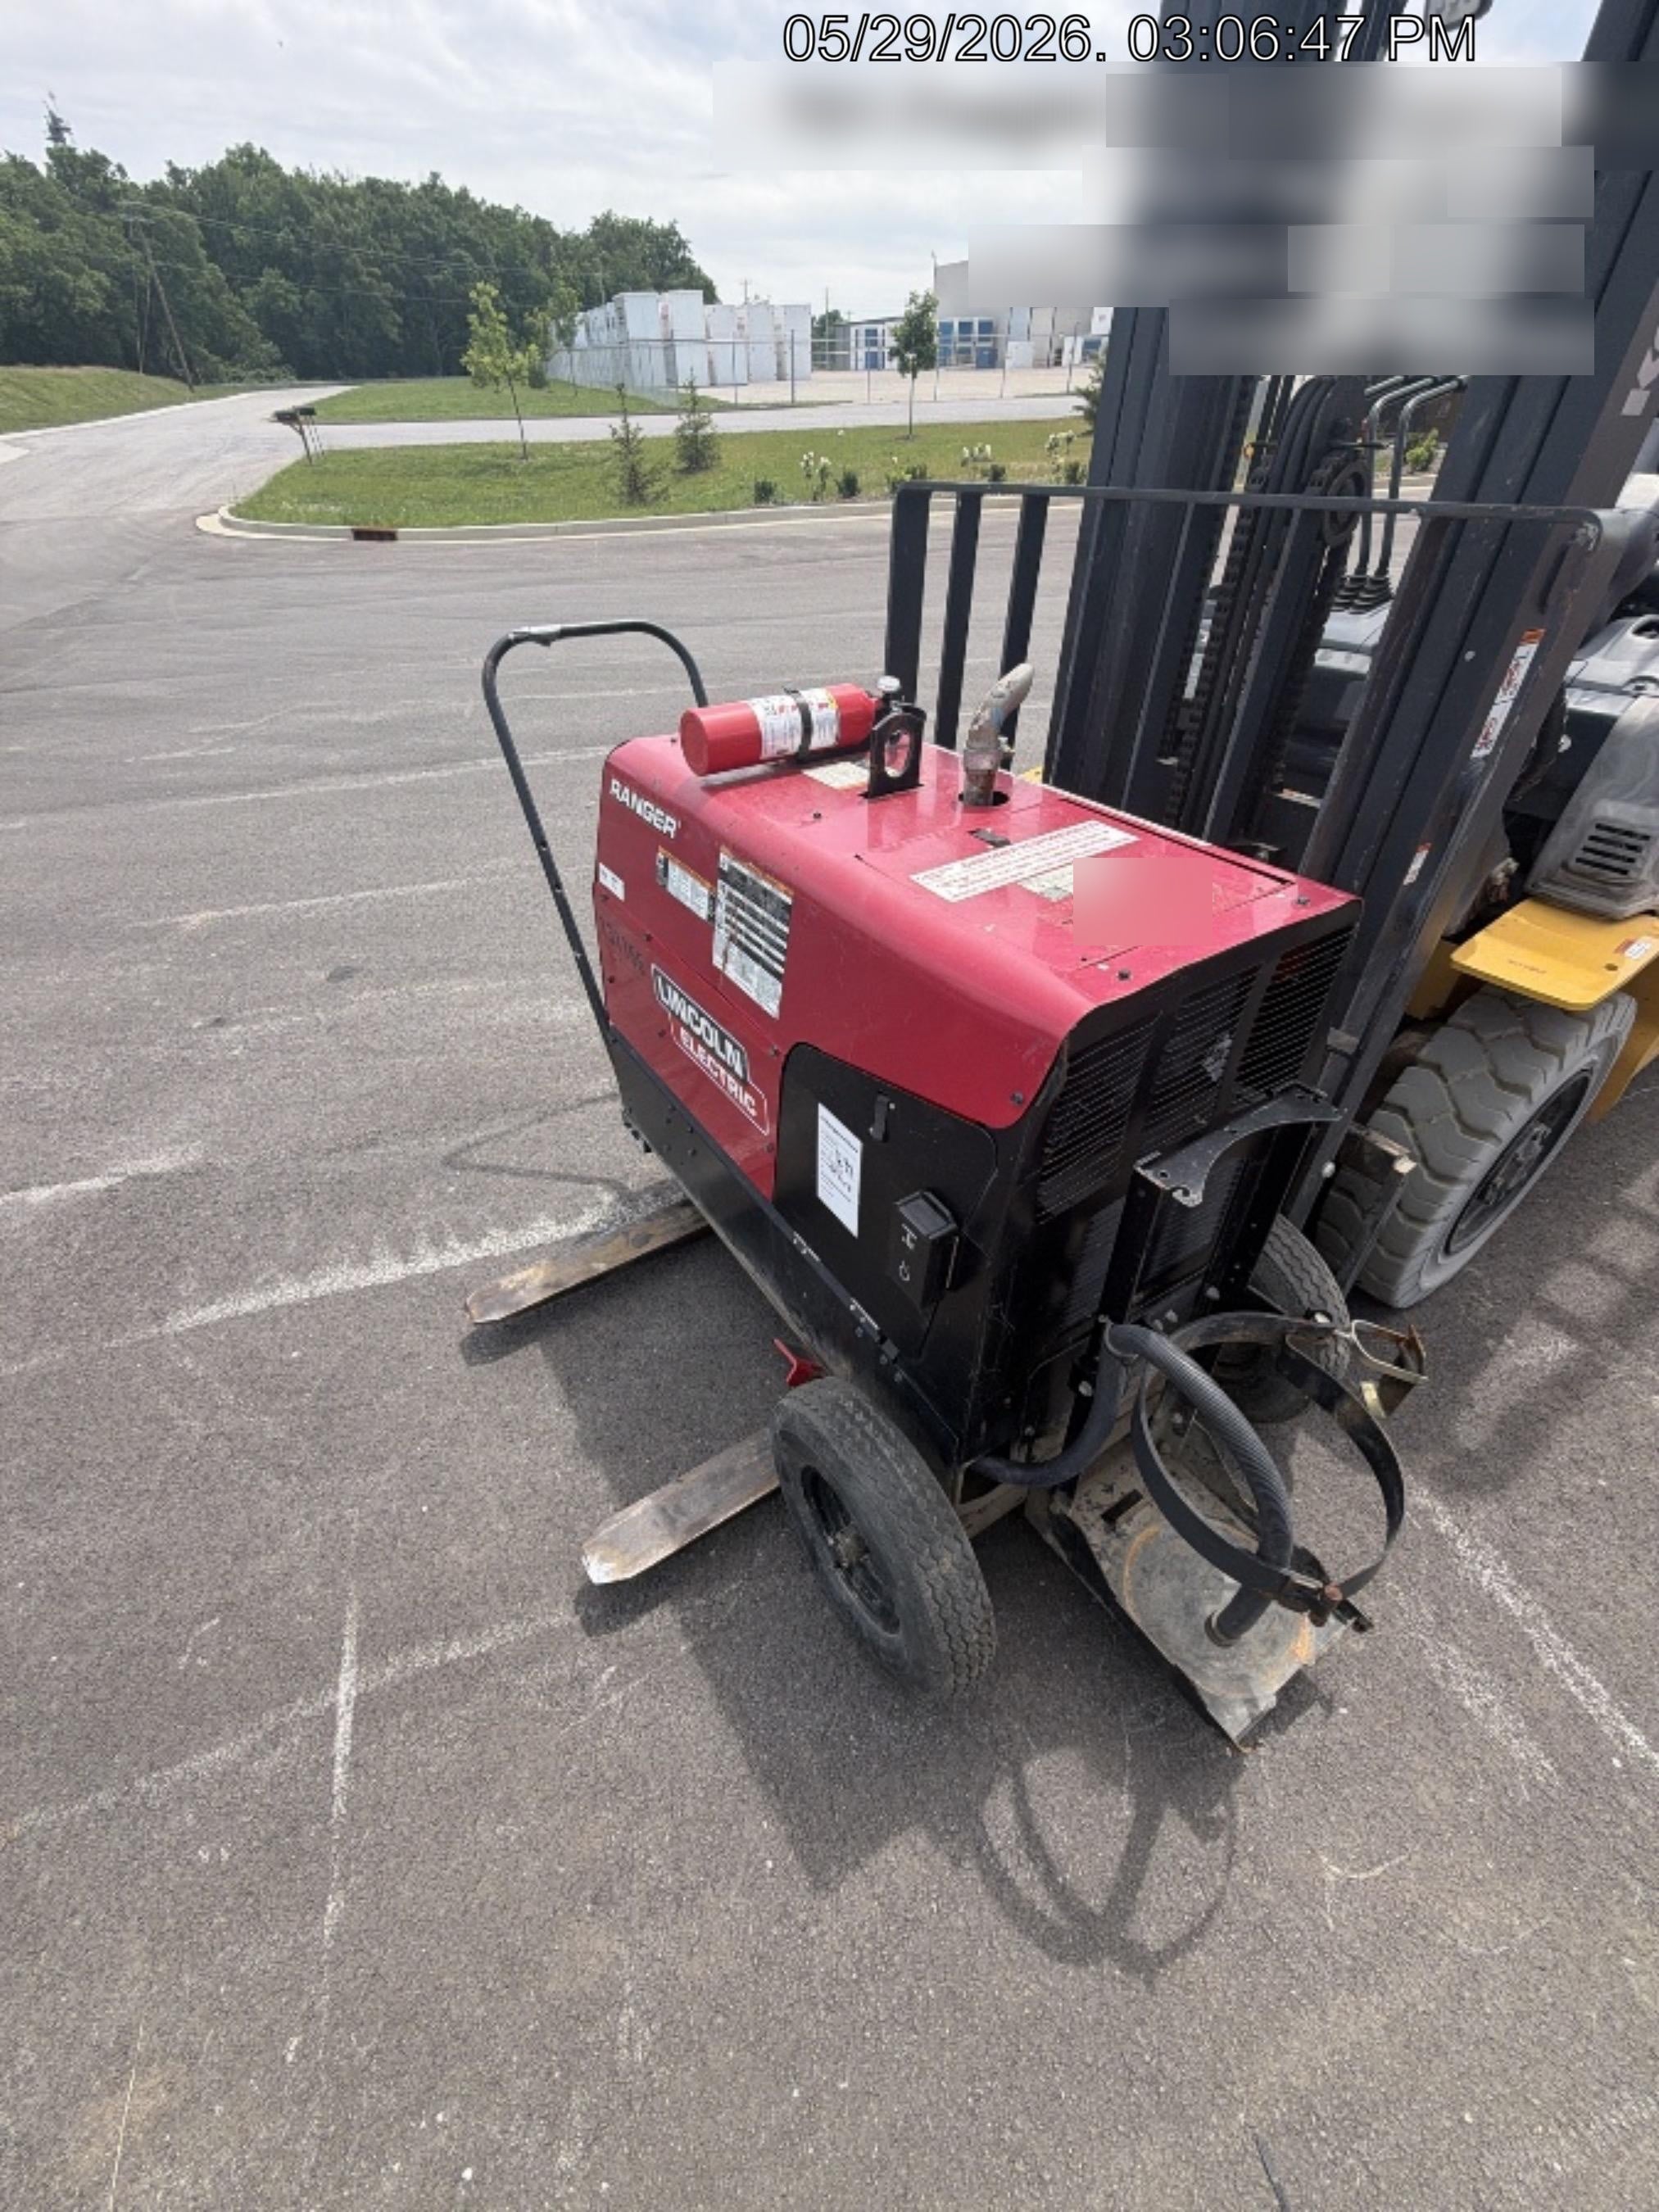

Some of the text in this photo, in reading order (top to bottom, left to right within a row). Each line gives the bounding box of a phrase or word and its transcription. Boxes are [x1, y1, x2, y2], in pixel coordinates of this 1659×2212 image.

[610, 779, 676, 838] RANGER
[658, 976, 744, 1078] LINCOLN
[680, 1026, 757, 1117] ELECTRIC
